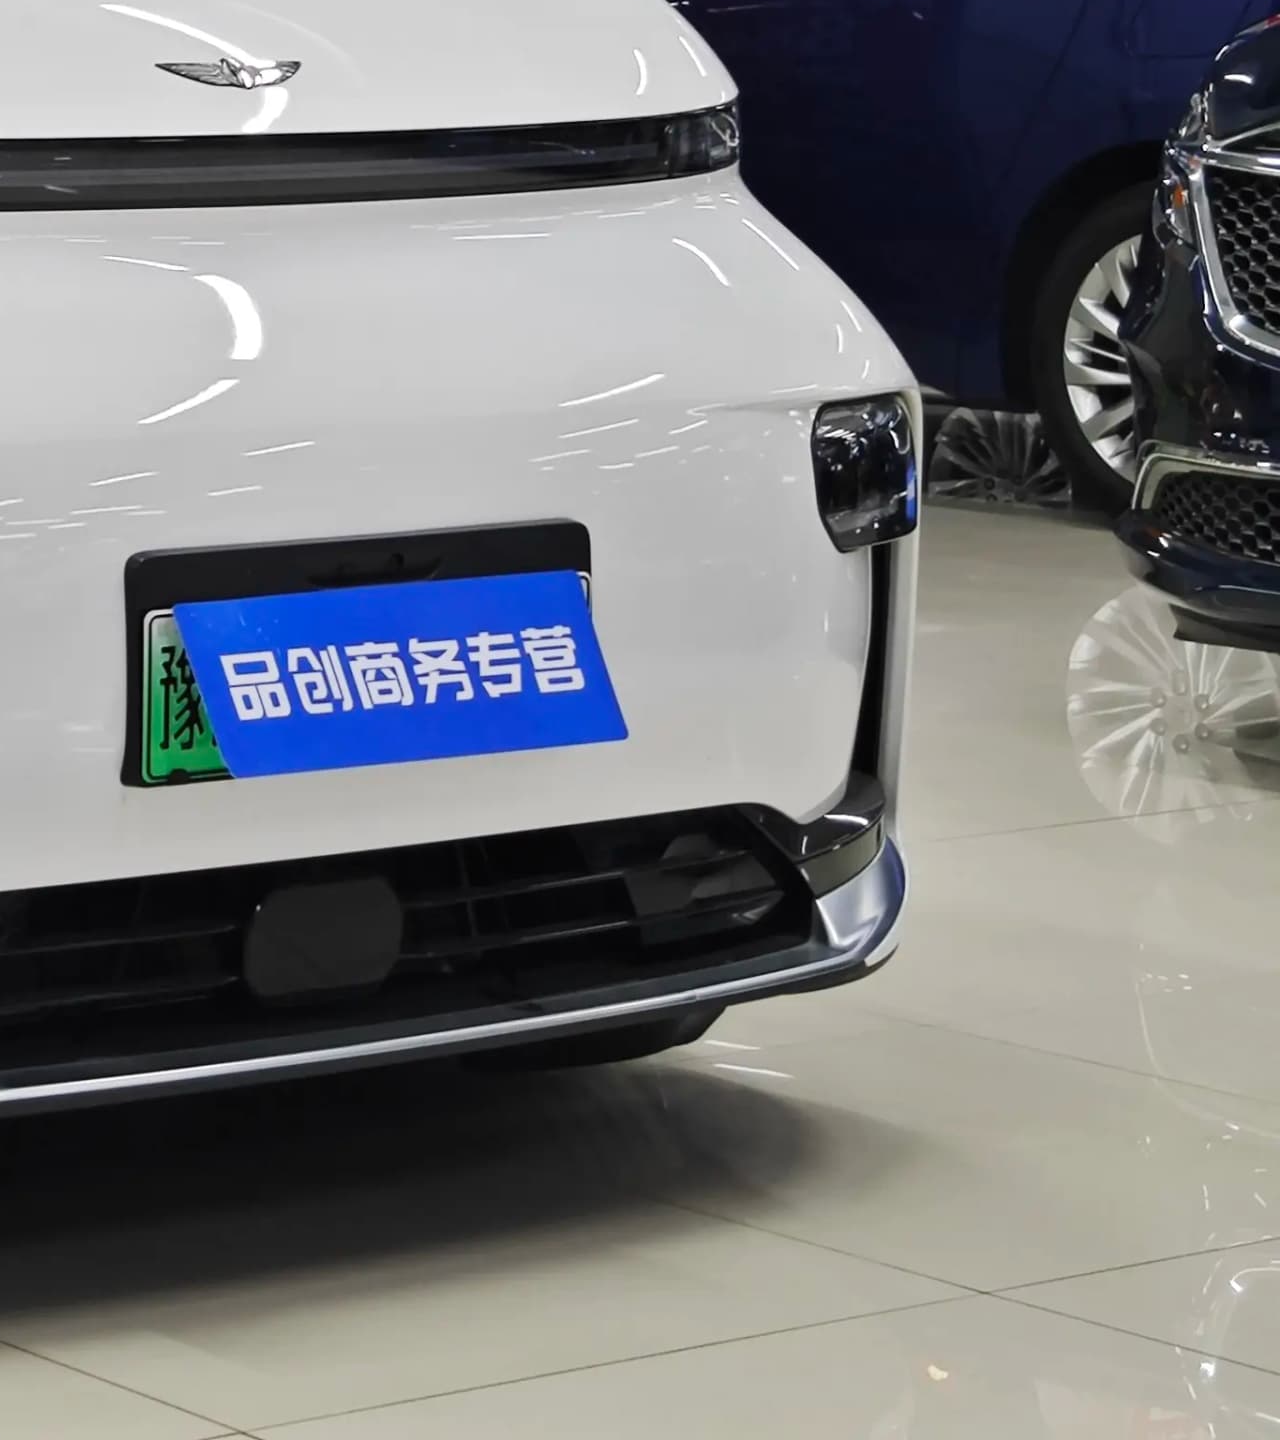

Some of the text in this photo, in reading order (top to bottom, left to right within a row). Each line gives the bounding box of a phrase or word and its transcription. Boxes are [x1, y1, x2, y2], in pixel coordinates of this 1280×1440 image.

[220, 625, 586, 721] 品创商务专营
